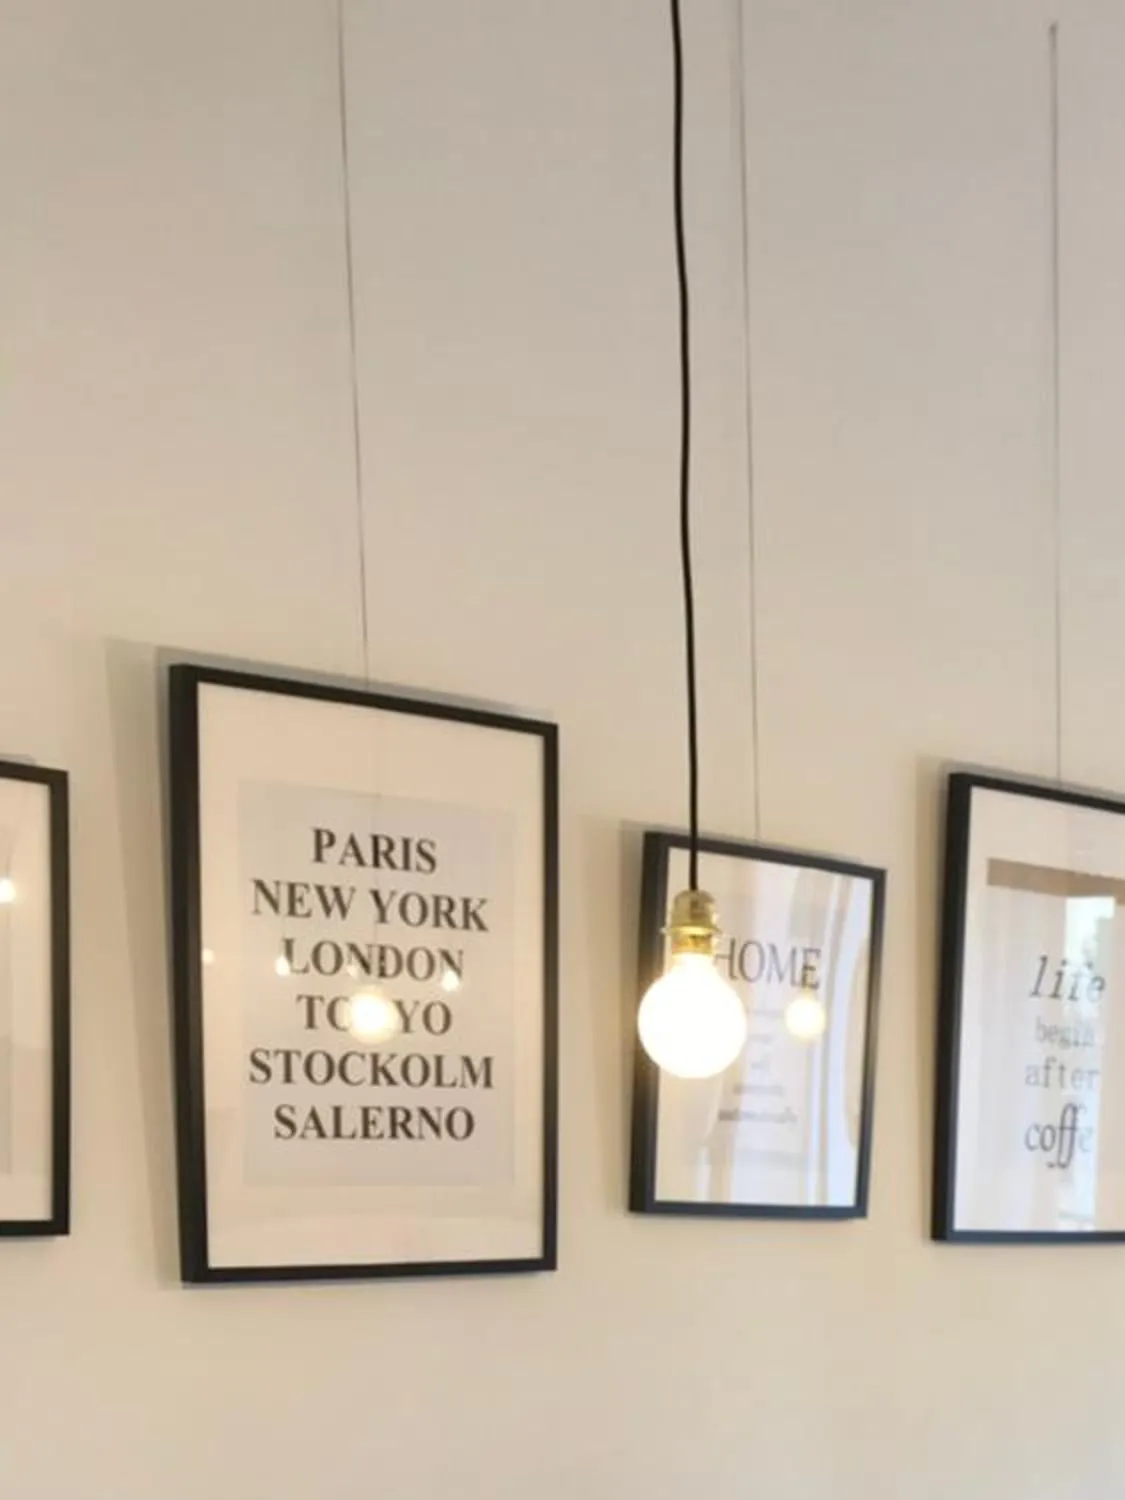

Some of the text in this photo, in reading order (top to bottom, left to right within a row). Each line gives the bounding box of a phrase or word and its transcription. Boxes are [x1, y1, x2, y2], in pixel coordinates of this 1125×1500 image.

[312, 827, 437, 874] PARIS
[252, 879, 489, 932] NEW YORK
[282, 937, 465, 981] LONDON
[296, 993, 452, 1036] TOYO
[249, 1048, 495, 1089] STOCKOLM
[1024, 1055, 1100, 1089] after
[273, 1103, 475, 1141] SALERNO
